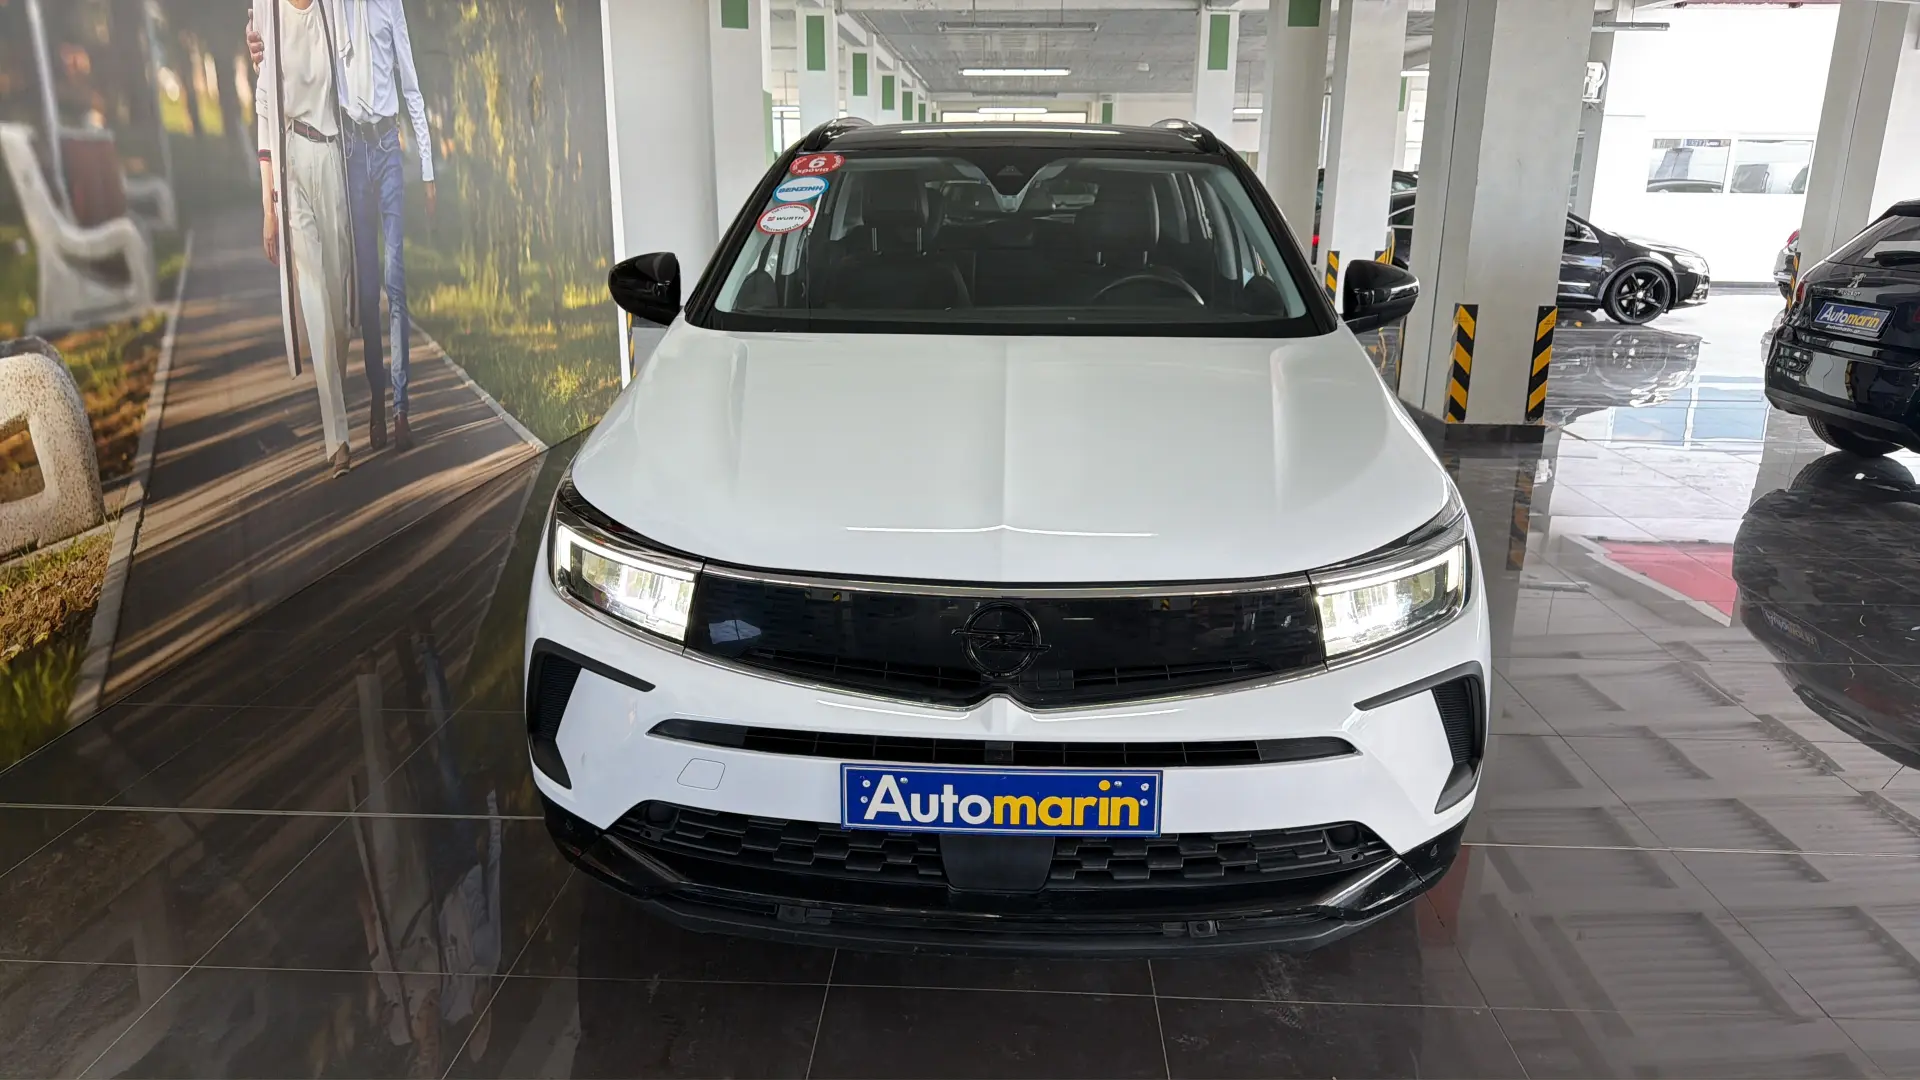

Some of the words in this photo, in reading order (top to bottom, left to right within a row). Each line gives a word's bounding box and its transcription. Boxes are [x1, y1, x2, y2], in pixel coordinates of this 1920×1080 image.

[809, 157, 827, 168] 6
[1820, 305, 1880, 328] Automarin
[863, 774, 1140, 826] Automarin
